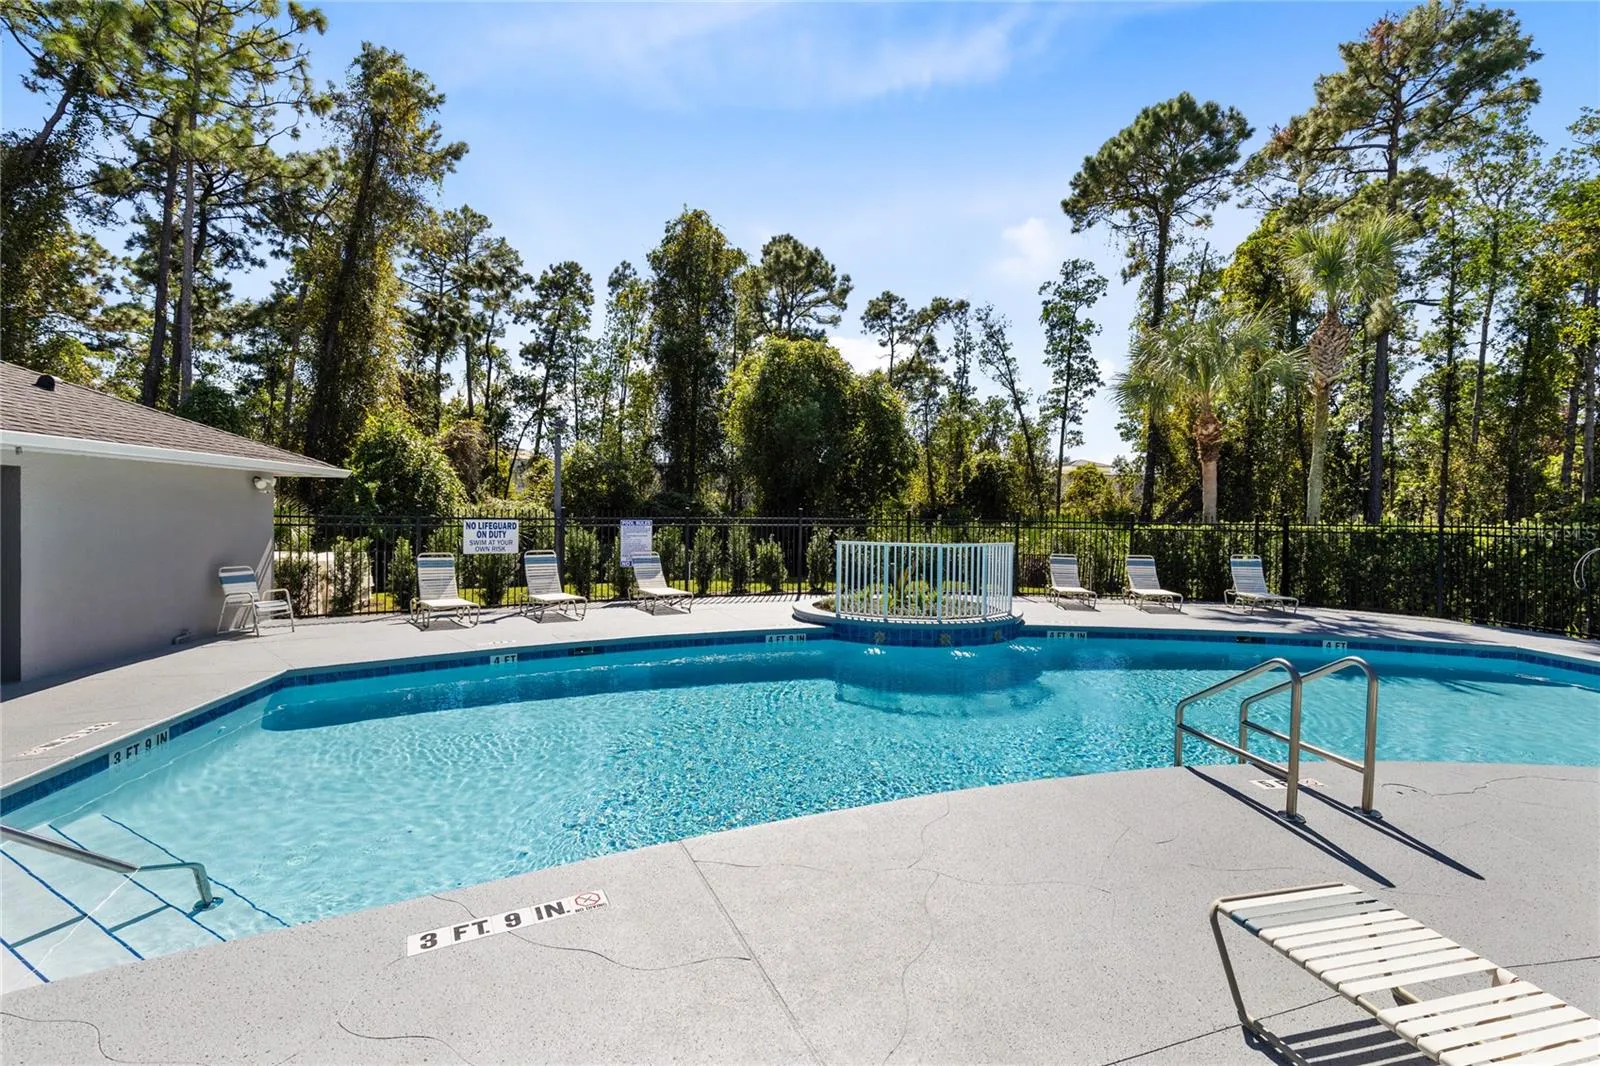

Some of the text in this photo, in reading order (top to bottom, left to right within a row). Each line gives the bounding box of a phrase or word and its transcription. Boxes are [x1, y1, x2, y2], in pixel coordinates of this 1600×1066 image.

[465, 521, 517, 530] NO LIFEGUARD
[476, 530, 507, 539] ON DUTY
[1326, 641, 1331, 649] 4
[493, 655, 516, 664] 4 FT
[113, 731, 168, 765] 3 FT 9 IN
[420, 901, 571, 950] 3 FT. 9 IN.
